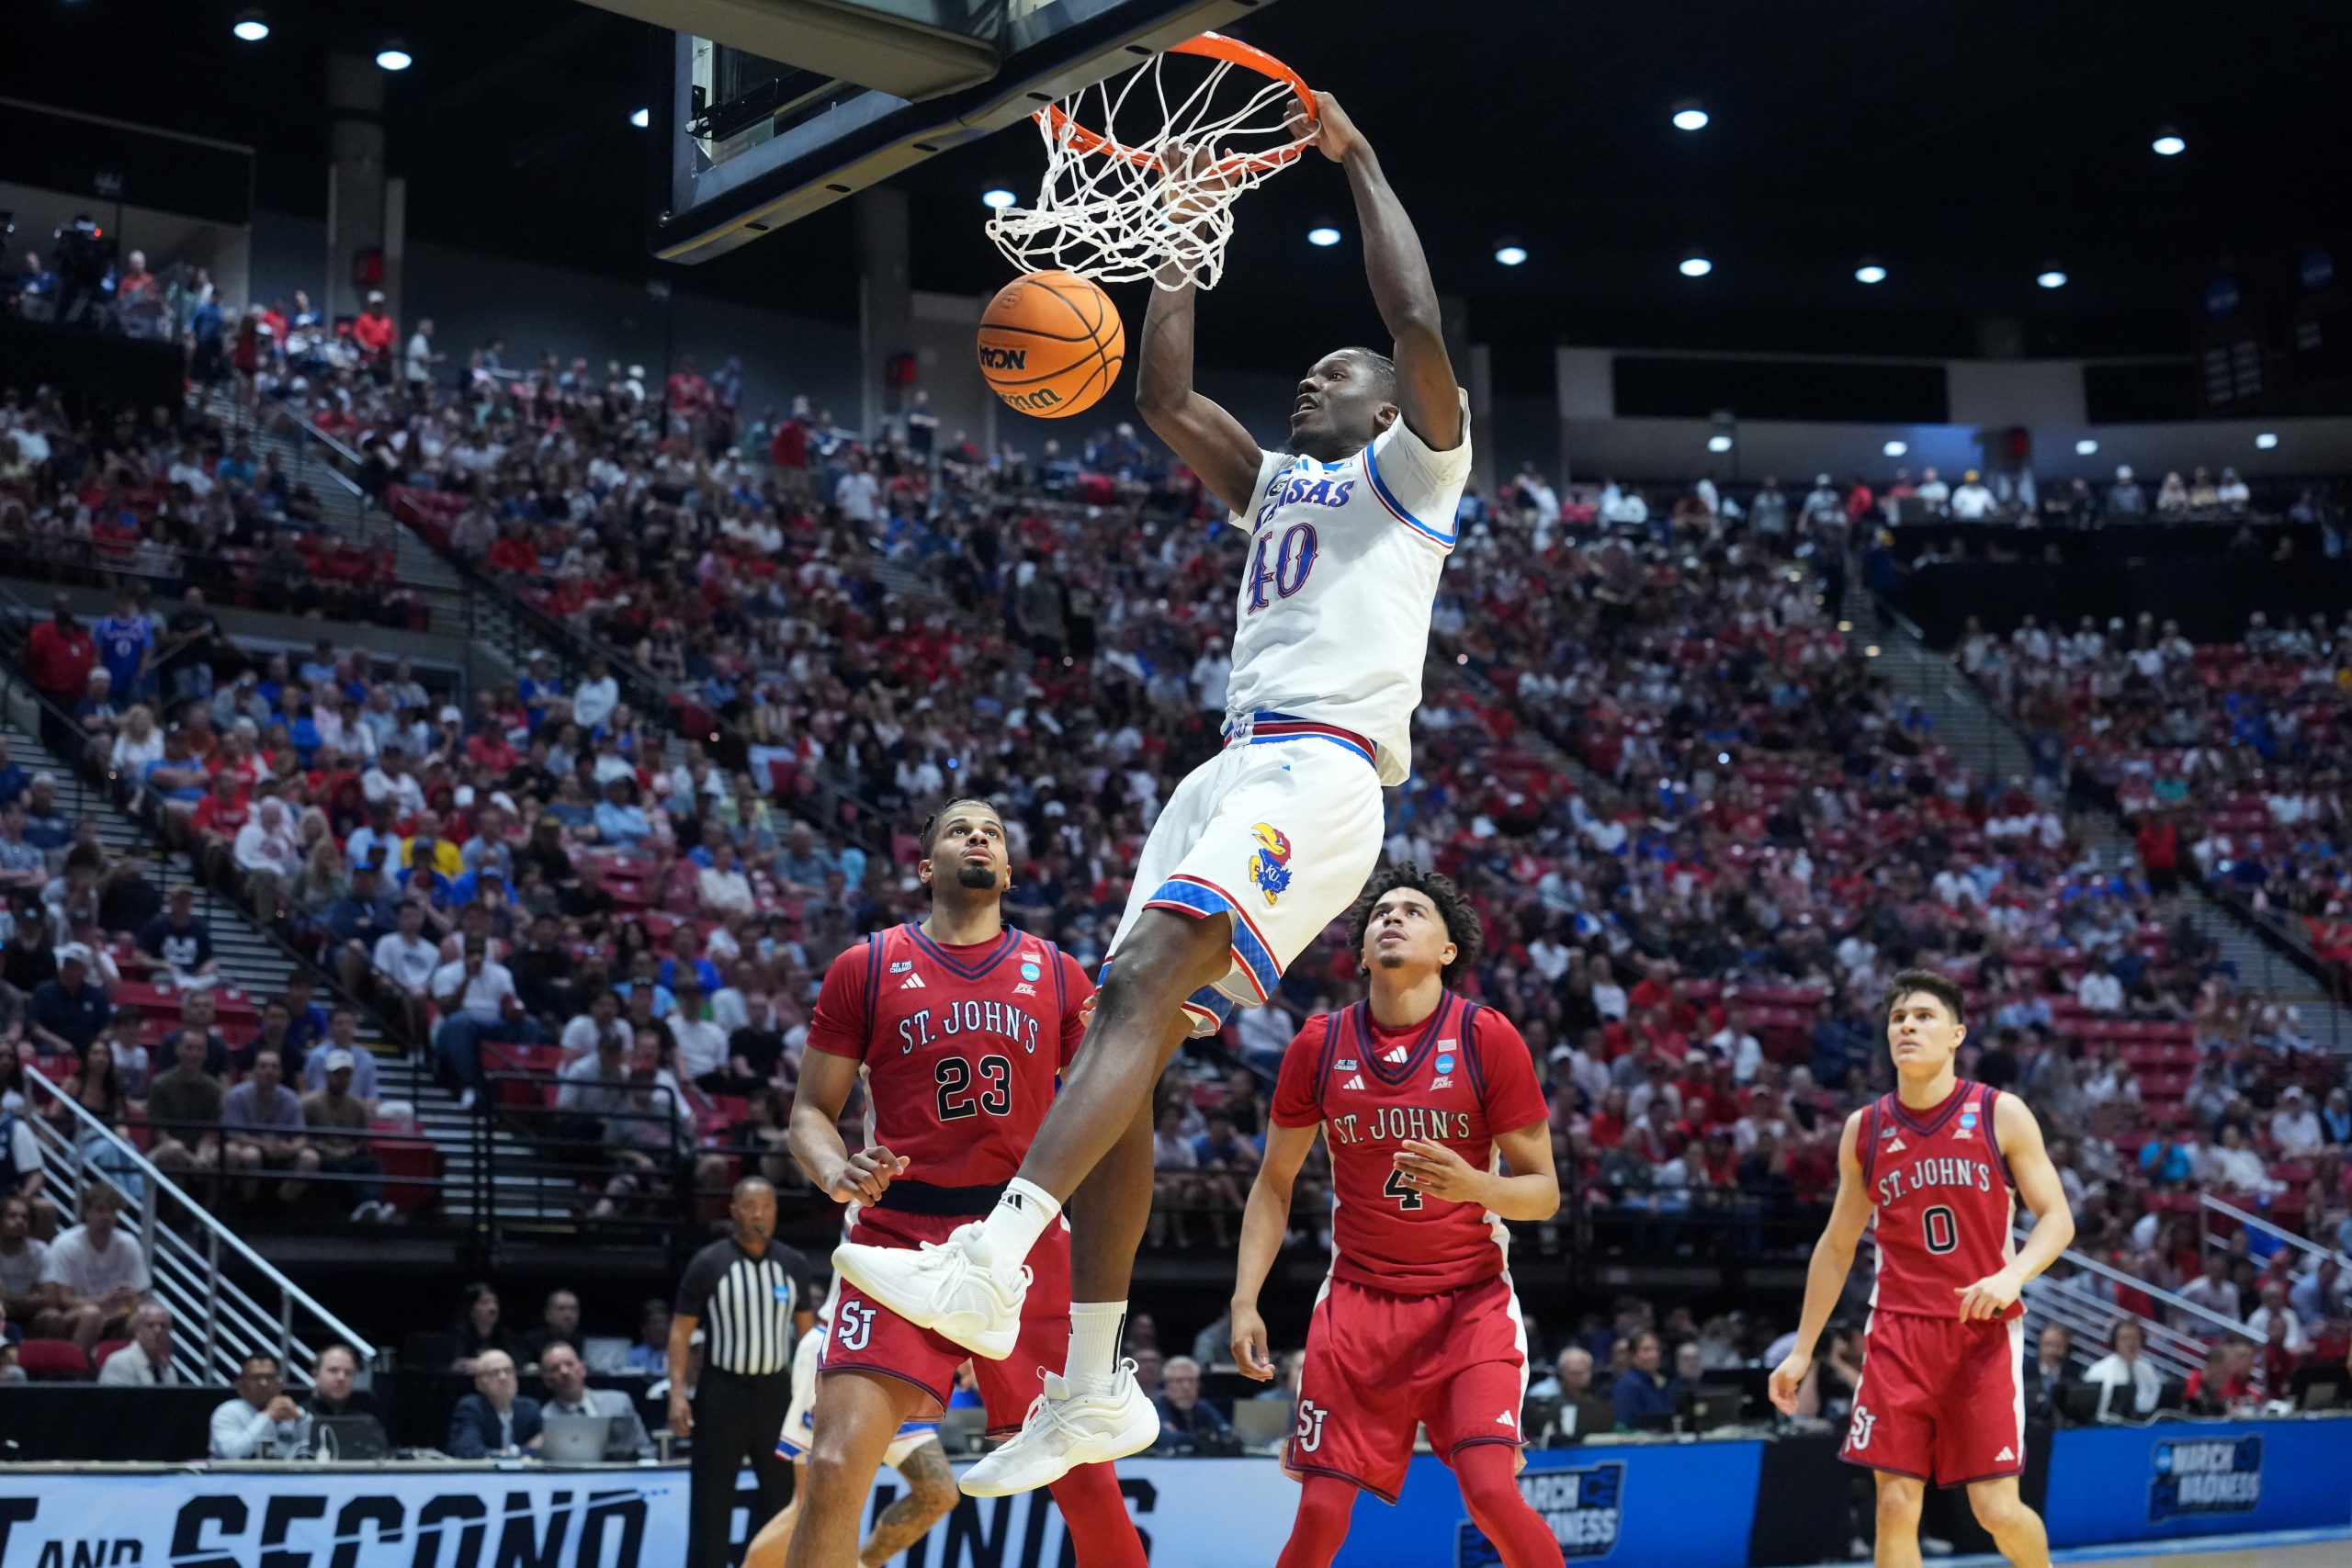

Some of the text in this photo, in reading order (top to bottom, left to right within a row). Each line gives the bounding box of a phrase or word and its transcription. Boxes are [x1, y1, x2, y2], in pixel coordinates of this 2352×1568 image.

[979, 345, 1026, 370] NCAA
[1247, 522, 1317, 615] 40
[1265, 864, 1281, 882] KU
[899, 999, 1039, 1055] ST. JOHN'S
[934, 1055, 1012, 1122] 23
[1334, 1106, 1471, 1145] ST. JOHN'S
[1384, 1152, 1423, 1211] 4
[1878, 1157, 1991, 1207] ST. JOHN'S
[1922, 1204, 1958, 1255] 0
[1516, 1473, 1581, 1511] ARCH
[38, 1540, 142, 1568] AND
[169, 1489, 649, 1568] SECOND
[1545, 1507, 1619, 1547] DNESS
